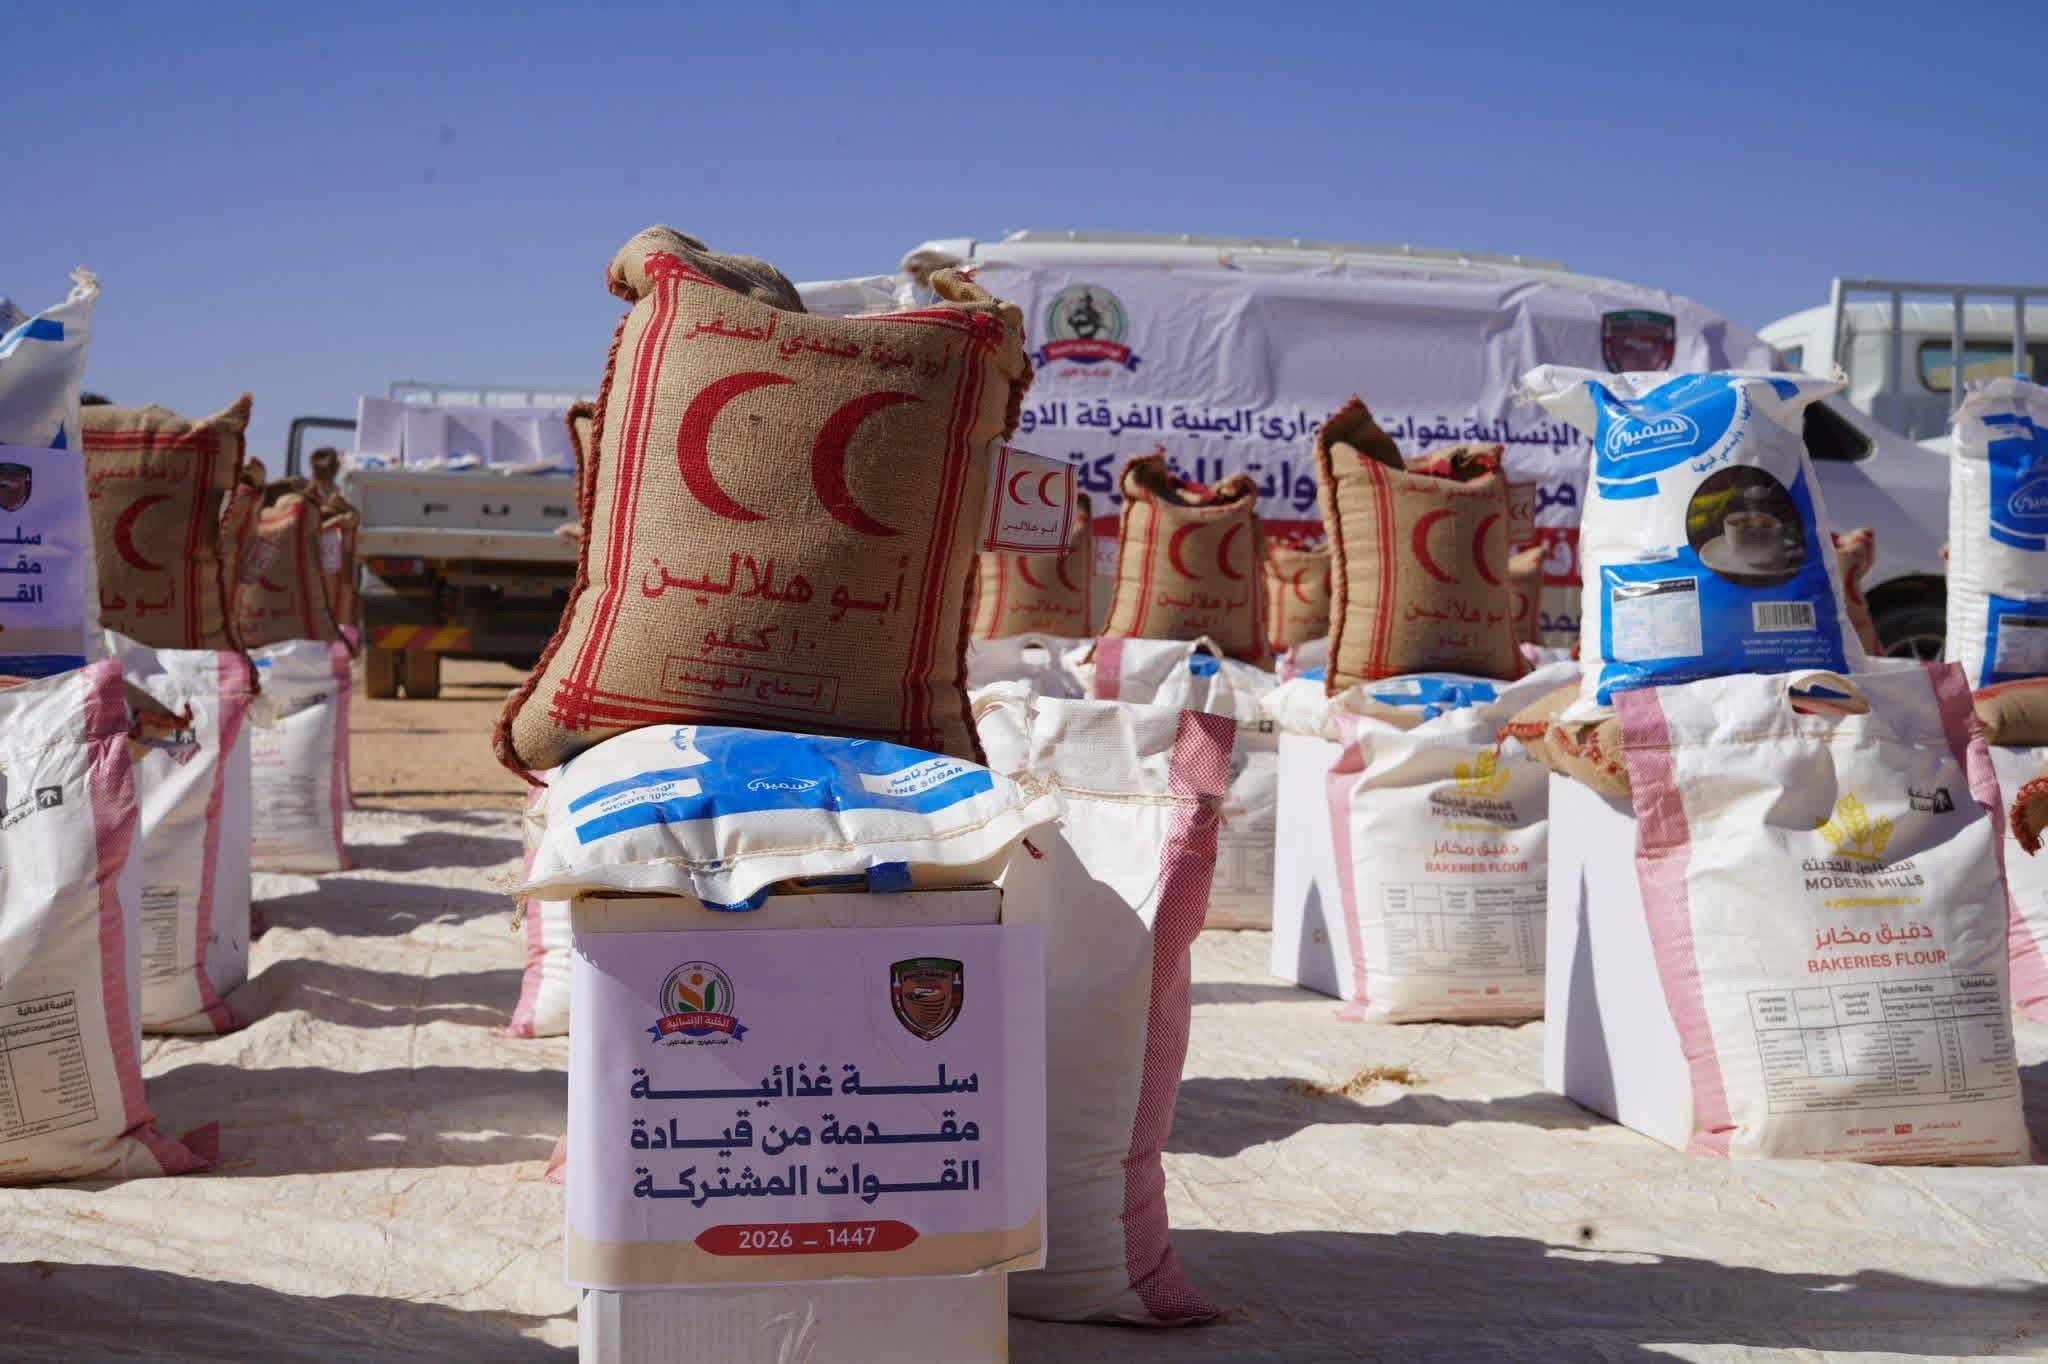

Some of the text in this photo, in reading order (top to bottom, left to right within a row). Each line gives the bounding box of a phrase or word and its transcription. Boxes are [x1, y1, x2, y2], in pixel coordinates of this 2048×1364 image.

[685, 310, 778, 342] أصفر
[1076, 398, 1164, 437] الفرقة
[1171, 405, 1253, 440] اليمنية
[641, 551, 910, 626] أبو هلالين
[701, 623, 779, 658] كيلو
[887, 766, 964, 795] FINE SUGAR
[1487, 860, 1529, 873] FLOUR
[1805, 873, 1926, 892] MODERN MILLS
[1815, 920, 1934, 951] دقيق مخابز
[1807, 948, 1948, 974] BAKERIES FLOUR
[630, 1063, 979, 1108] سلة غذائية
[630, 1109, 980, 1158] مقدمة من قيادة
[633, 1158, 980, 1209] القوات المشتركة
[737, 1229, 794, 1250] 2026
[827, 1226, 877, 1248] 1447
